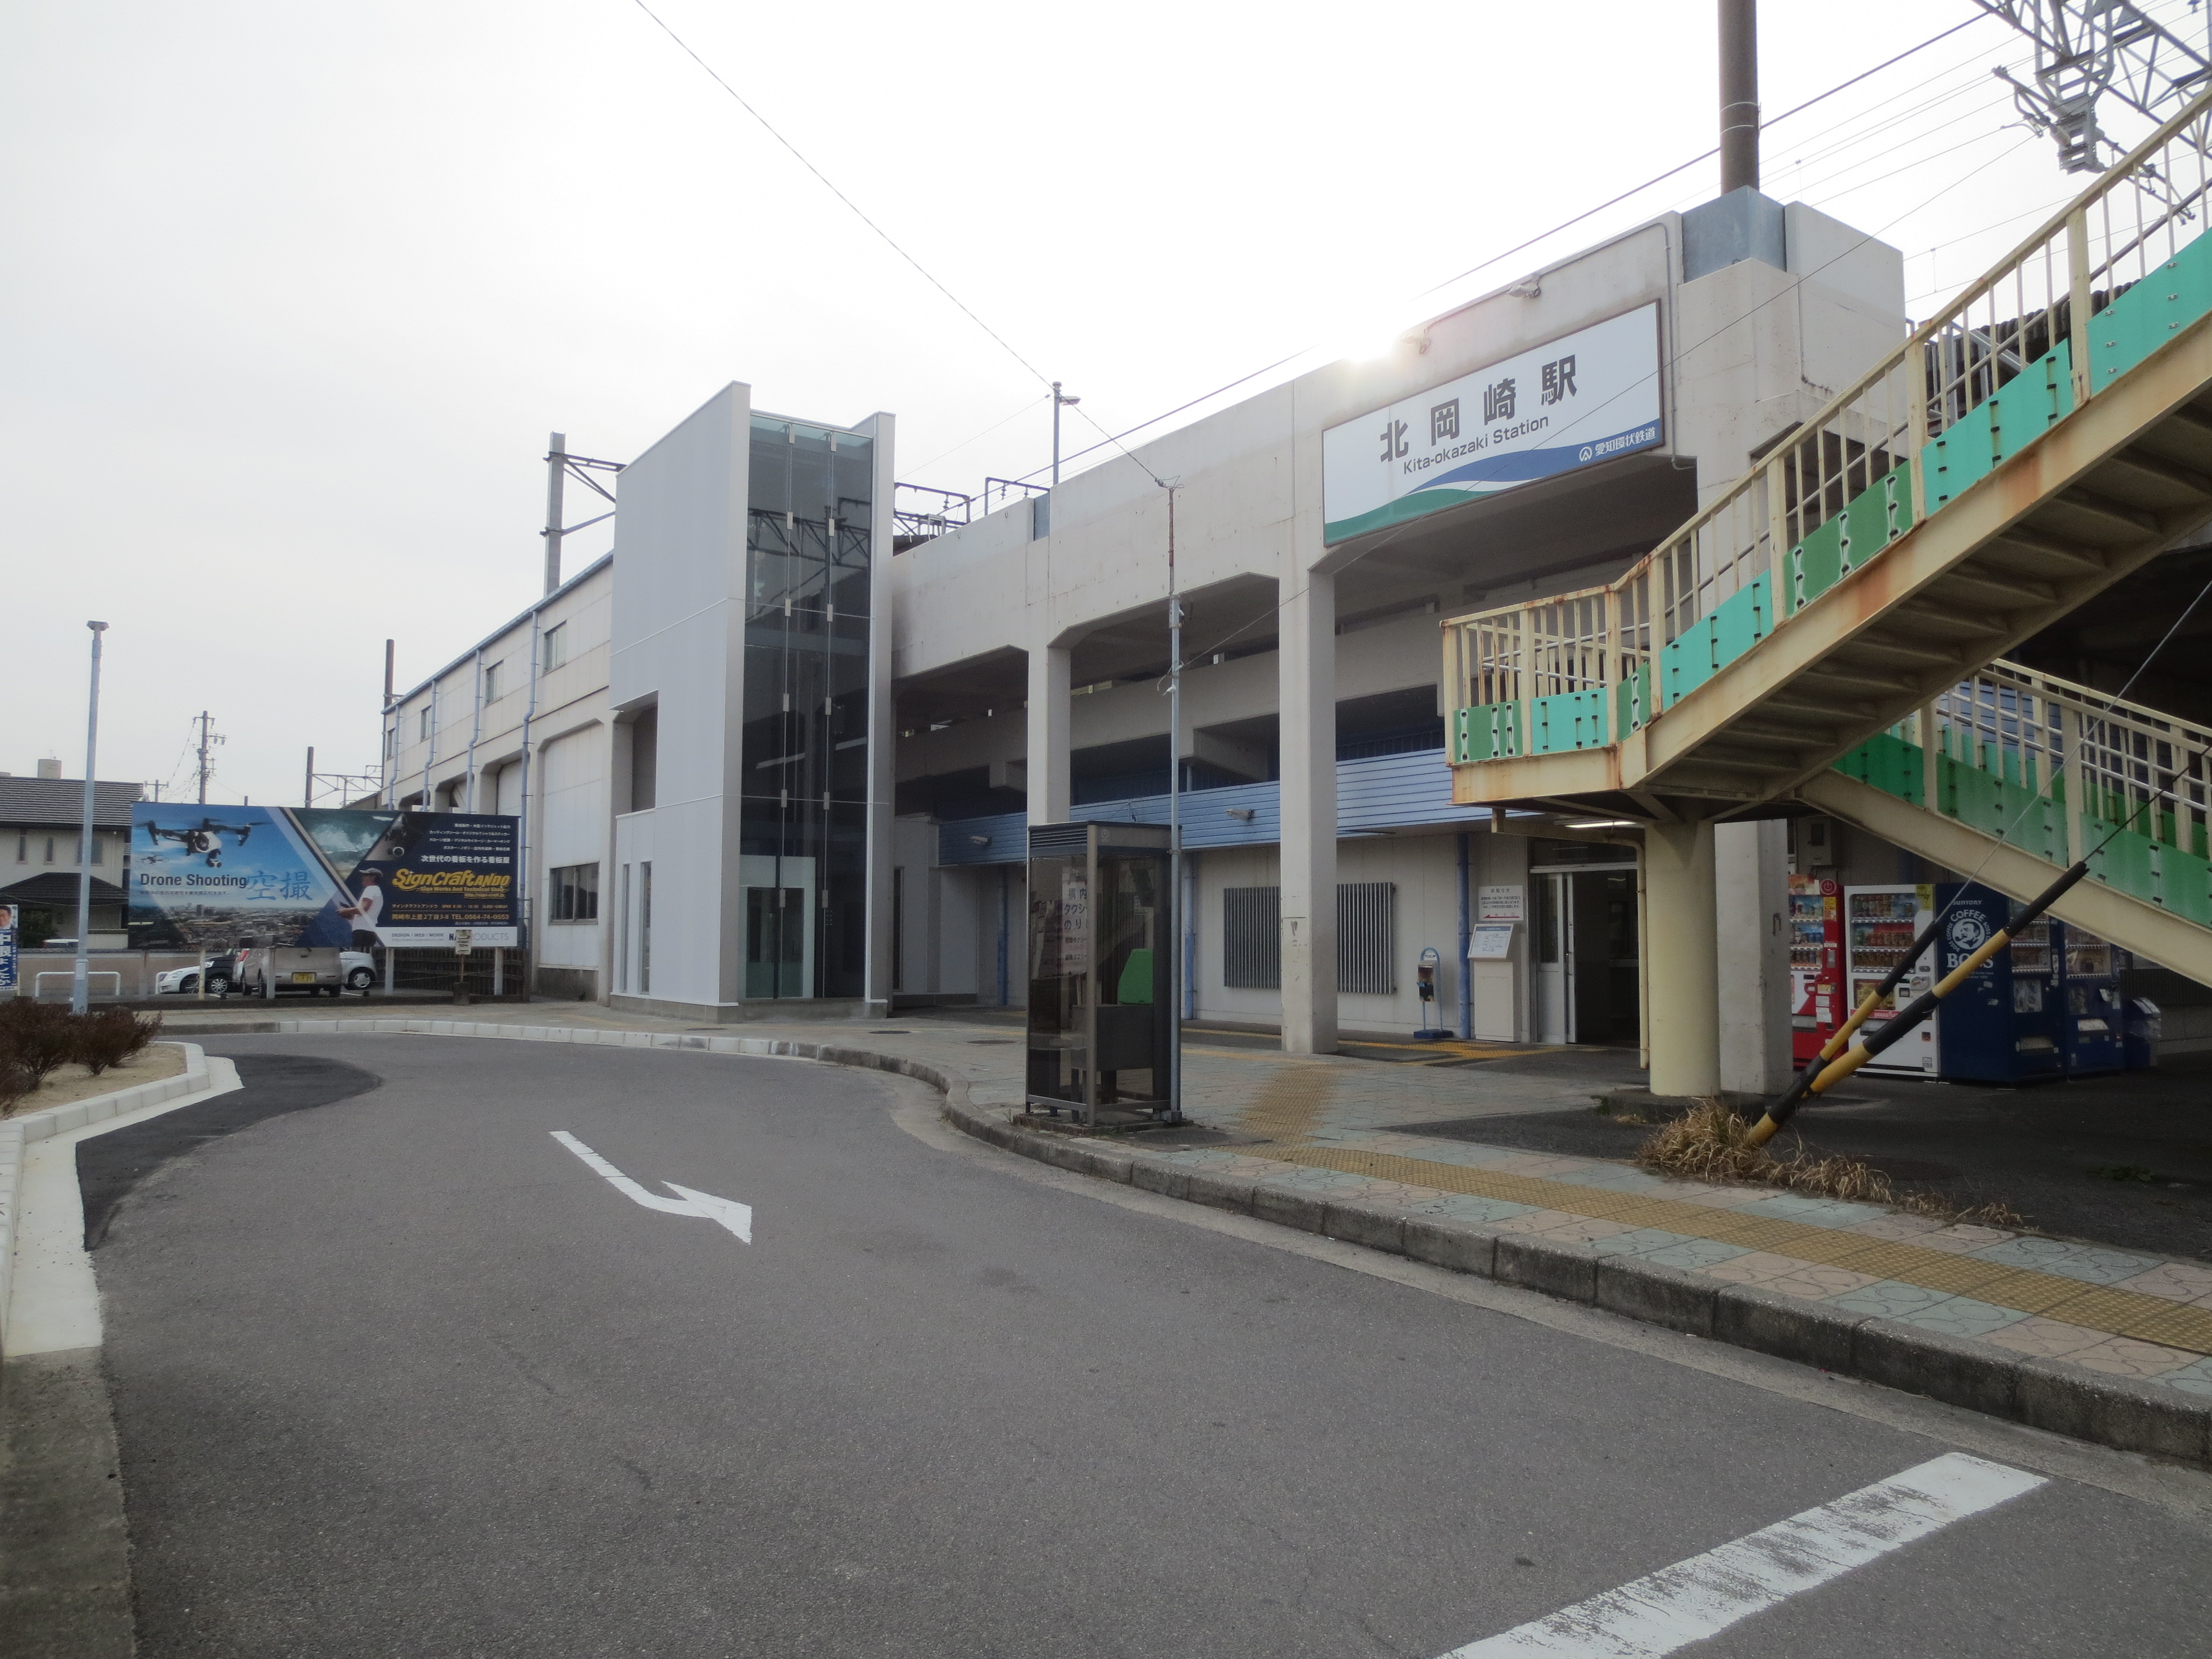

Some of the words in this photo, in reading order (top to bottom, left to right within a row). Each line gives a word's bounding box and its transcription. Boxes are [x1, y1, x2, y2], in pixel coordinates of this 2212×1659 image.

[1380, 354, 1577, 463] 北岡崎駅
[1404, 433, 1488, 475] Kita-okazaki
[1493, 416, 1549, 444] Station
[1595, 426, 1656, 457] 愛知環状鉄道
[421, 855, 510, 864] 次世代の看板を作る看板屋
[141, 873, 182, 886] Drone
[186, 873, 247, 889] Shooting
[246, 870, 313, 901] 空撮
[1064, 903, 1087, 915] タクシ
[1950, 909, 1987, 922] COFFEE
[1947, 953, 1994, 968] BOS
